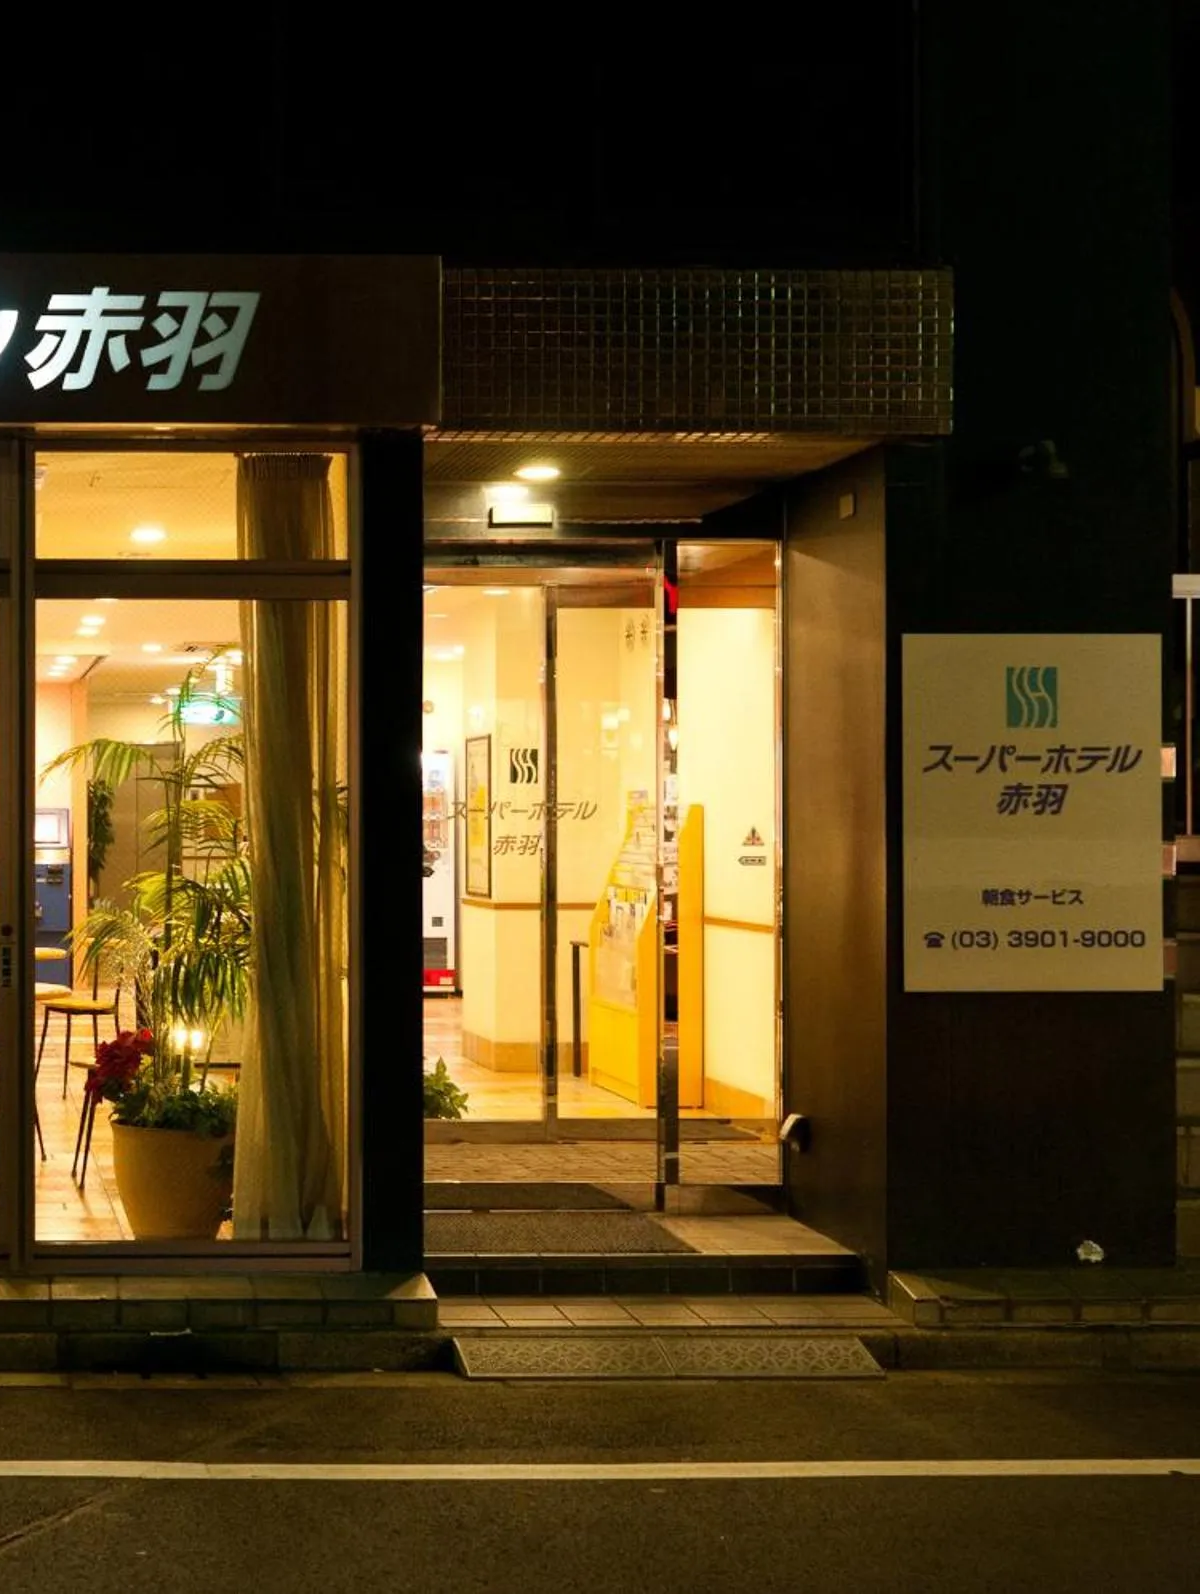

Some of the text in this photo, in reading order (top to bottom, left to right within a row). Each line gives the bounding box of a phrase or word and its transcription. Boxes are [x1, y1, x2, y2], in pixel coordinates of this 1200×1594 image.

[922, 744, 1143, 774] スーパーホテル
[997, 782, 1068, 816] 赤羽
[493, 835, 541, 856] 赤羽
[951, 929, 1146, 951] (03) 3901-9000
